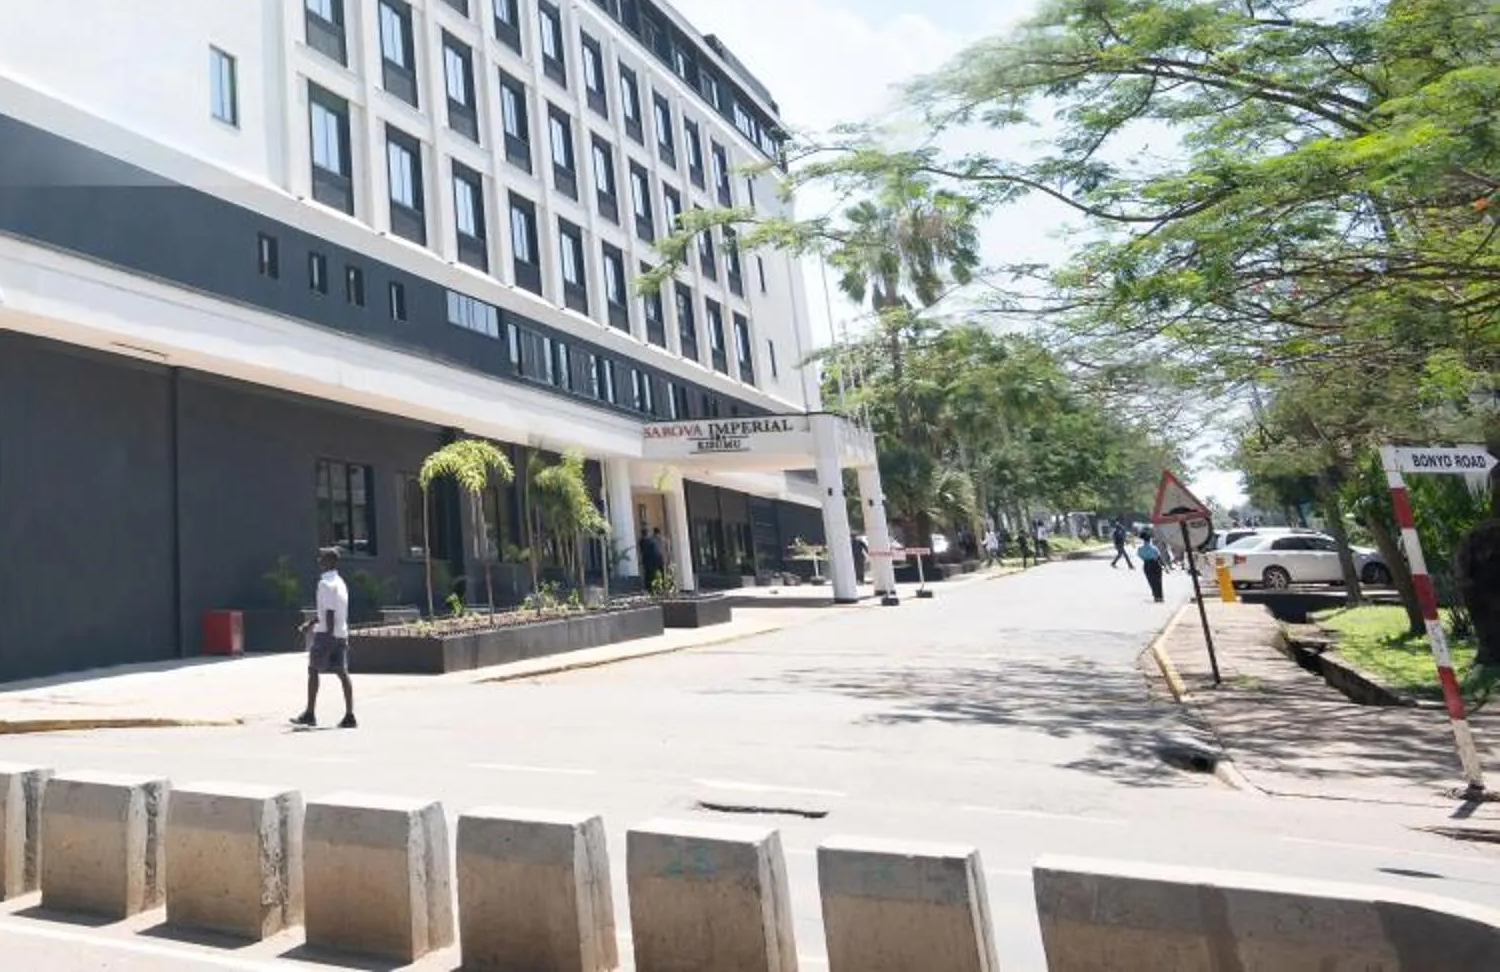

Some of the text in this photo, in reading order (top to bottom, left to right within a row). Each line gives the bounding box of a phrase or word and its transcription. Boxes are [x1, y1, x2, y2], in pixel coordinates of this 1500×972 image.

[643, 419, 794, 439] SAROVA IMPERIAL
[1411, 453, 1486, 468] BONYO ROAD
